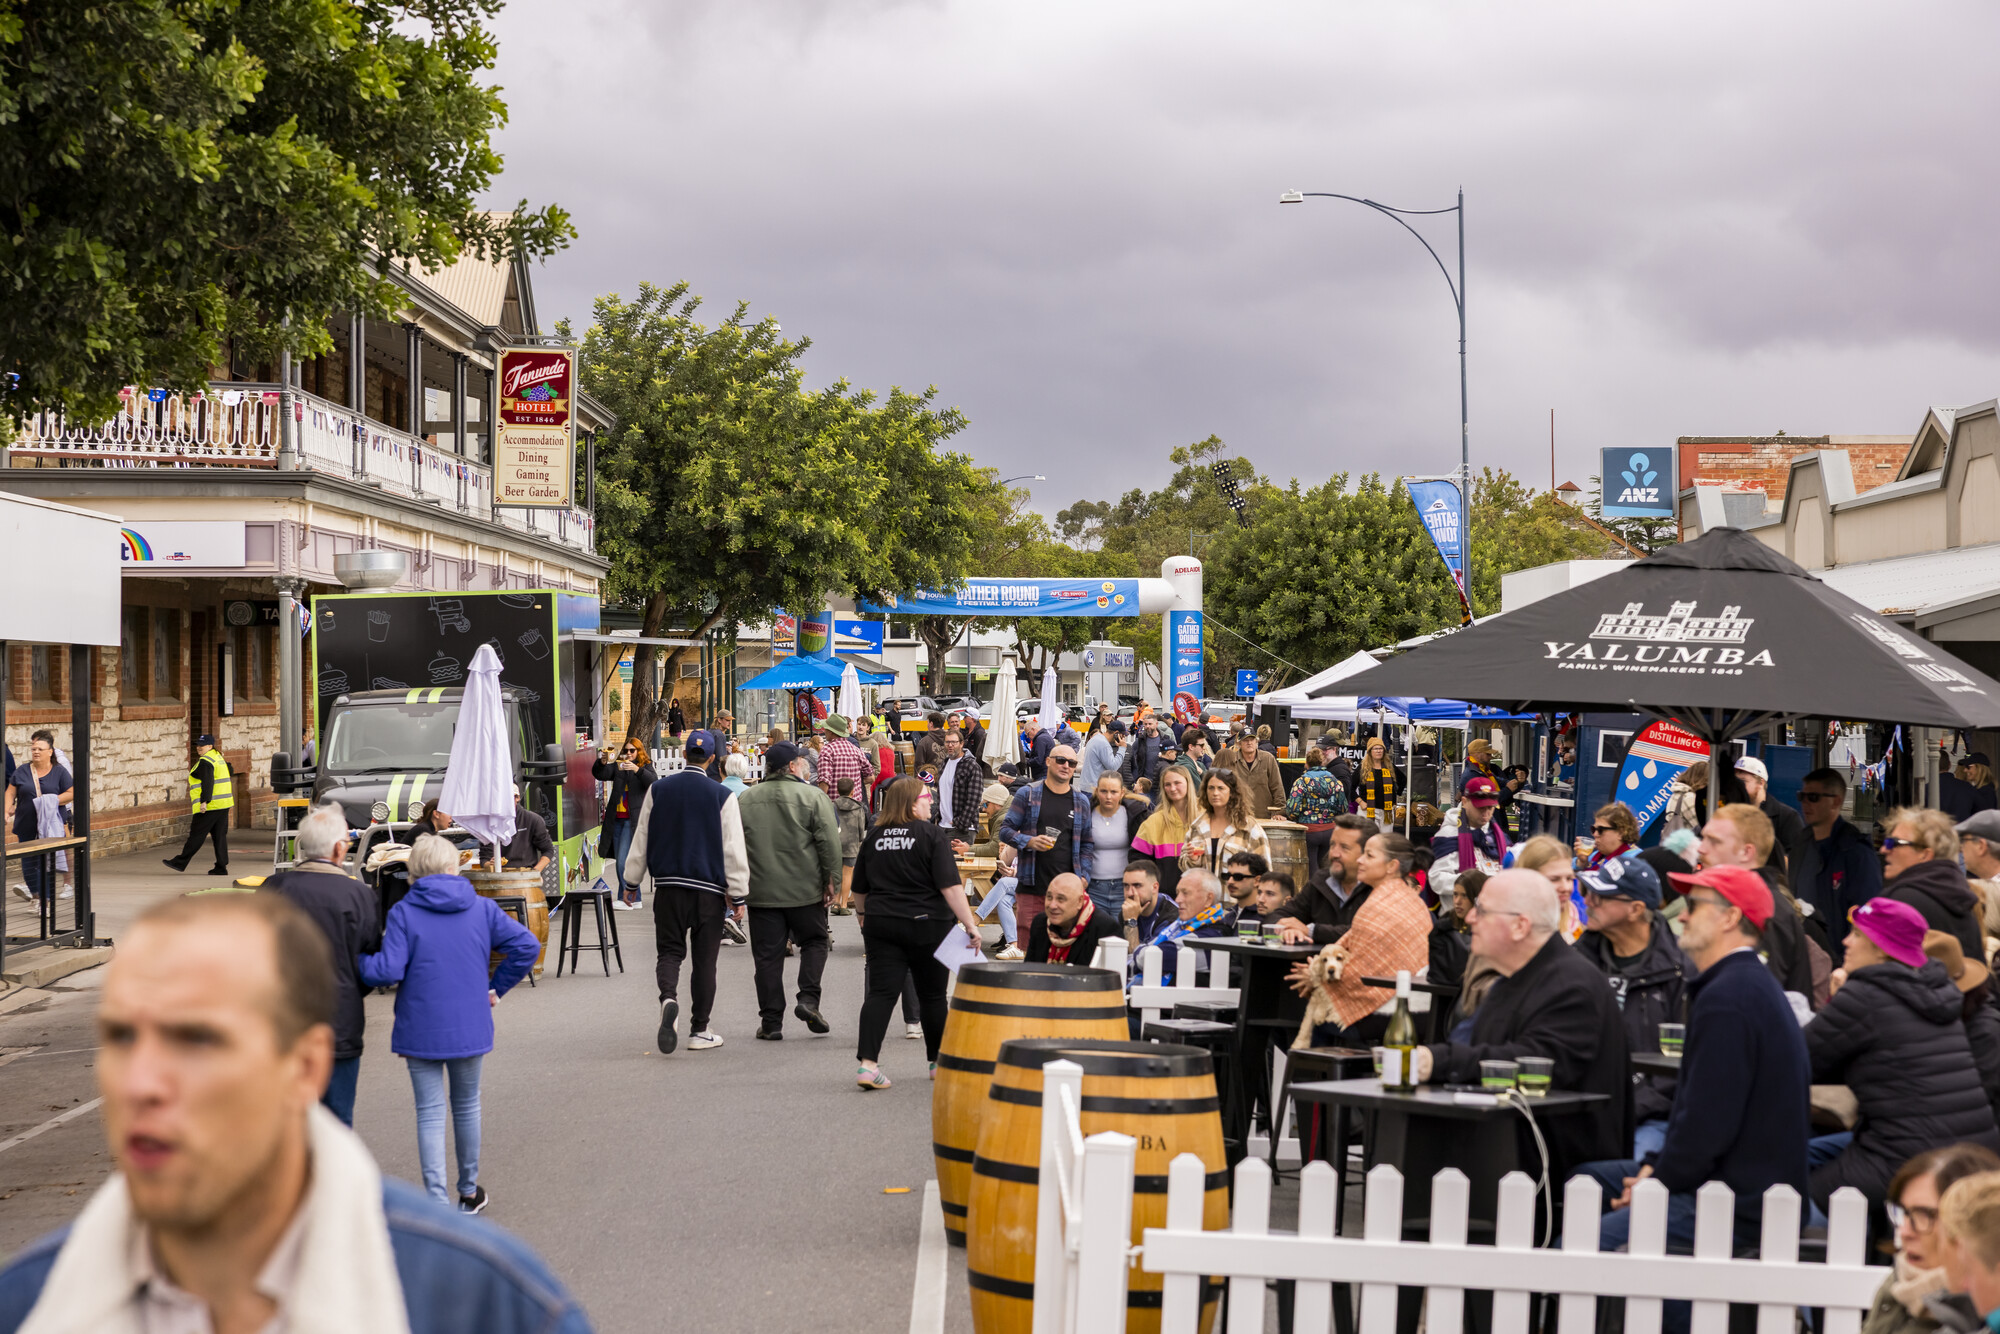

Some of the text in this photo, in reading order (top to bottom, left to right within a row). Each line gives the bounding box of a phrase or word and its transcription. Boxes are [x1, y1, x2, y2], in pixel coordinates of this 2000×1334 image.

[503, 359, 566, 396] Tanunda
[516, 402, 553, 412] HOTEL
[503, 434, 564, 446] Accommodation
[518, 451, 548, 465] Dining
[516, 469, 550, 482] Gaming
[505, 485, 559, 497] Beer Garden
[1617, 487, 1659, 503] ANZ
[1174, 566, 1201, 574] ADELAIDE
[1000, 585, 1039, 601] ROUND
[1177, 624, 1200, 635] GATHER
[1178, 634, 1199, 645] ROUND
[1543, 641, 1776, 667] YALUMBA
[1557, 662, 1743, 676] FAMILY WINEMAKERS 1849
[781, 680, 814, 688] HAHN
[1649, 730, 1691, 747] DISTILLING
[1338, 746, 1367, 760] MENU
[883, 828, 909, 836] EVENT
[874, 837, 916, 851] CREW
